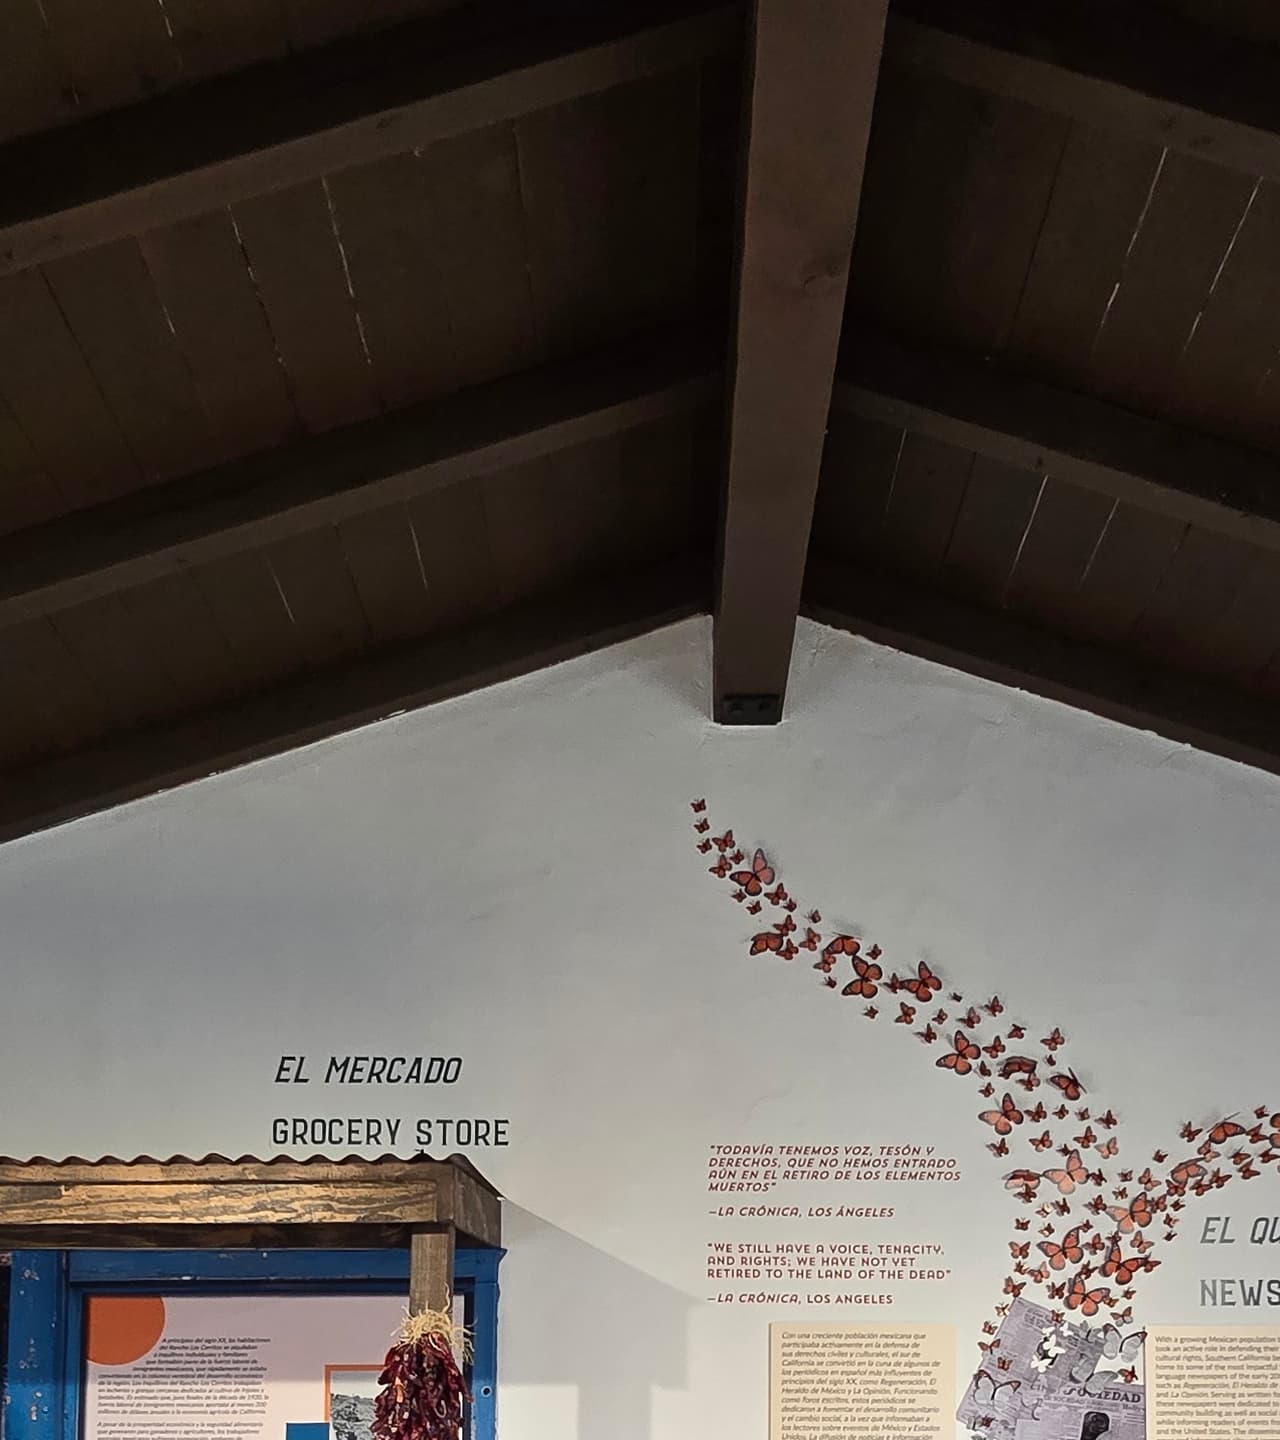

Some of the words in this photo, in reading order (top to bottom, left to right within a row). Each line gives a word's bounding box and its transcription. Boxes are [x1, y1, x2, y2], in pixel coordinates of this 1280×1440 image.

[274, 1056, 310, 1083] EL
[324, 1056, 462, 1083] MERCADO
[273, 1118, 400, 1145] GROCERY
[416, 1119, 509, 1145] STORE
[779, 1146, 839, 1155] TENEMOS
[845, 1146, 873, 1156] VOZ,
[879, 1145, 920, 1155] TESÓN
[926, 1146, 935, 1155] Y
[709, 1158, 781, 1169] DERECHOS,
[788, 1159, 813, 1168] QUE
[819, 1159, 838, 1168] NO
[844, 1159, 888, 1168] HEMOS
[894, 1159, 956, 1168] ENTRADO
[709, 1169, 736, 1179] AÚN
[742, 1170, 758, 1179] EN
[764, 1170, 777, 1179] EL
[783, 1170, 829, 1180] RETIRO
[835, 1171, 851, 1180] DE
[857, 1171, 879, 1180] LOS
[885, 1171, 961, 1180] ELEMENTOS
[740, 1205, 802, 1218] CRÓNICA,
[808, 1207, 832, 1217] LOS
[836, 1206, 894, 1217] ÁNGELES
[1200, 1217, 1235, 1243] EL
[738, 1243, 771, 1253] STILL
[777, 1244, 810, 1254] HAVE
[816, 1244, 824, 1254] A
[830, 1244, 873, 1255] VOICE,
[878, 1245, 944, 1255] TENACITY,
[708, 1256, 734, 1266] AND
[741, 1256, 791, 1267] RIGHTS;
[797, 1257, 816, 1266] WE
[822, 1257, 855, 1266] HAVE
[861, 1257, 887, 1266] NOT
[892, 1257, 915, 1266] YET
[708, 1269, 760, 1279] RETIRED
[766, 1269, 782, 1279] TO
[788, 1269, 811, 1279] THE
[818, 1269, 852, 1279] LAND
[858, 1270, 875, 1279] OF
[879, 1270, 903, 1279] THE
[739, 1292, 801, 1304] CRÓNICA,
[807, 1294, 830, 1304] LOS
[835, 1294, 893, 1304] ANGELES
